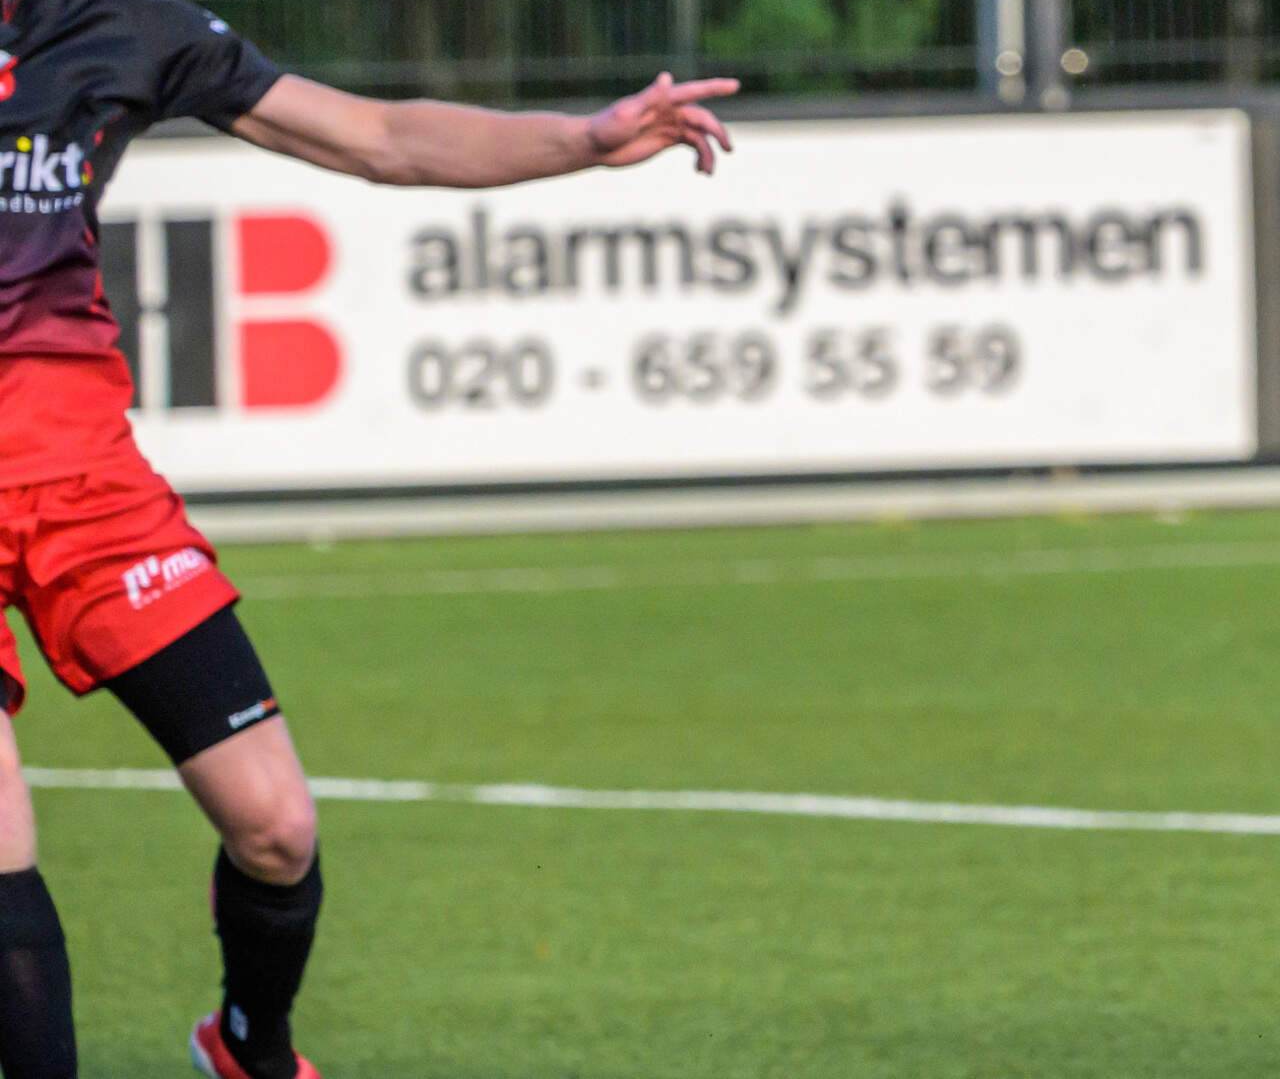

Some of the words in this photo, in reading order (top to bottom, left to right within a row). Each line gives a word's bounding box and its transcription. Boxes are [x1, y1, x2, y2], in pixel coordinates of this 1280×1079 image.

[407, 194, 1205, 314] alarmsystemen
[407, 338, 555, 410] 020
[632, 333, 777, 402] 659
[802, 329, 899, 399] 55
[926, 324, 1022, 395] 59
